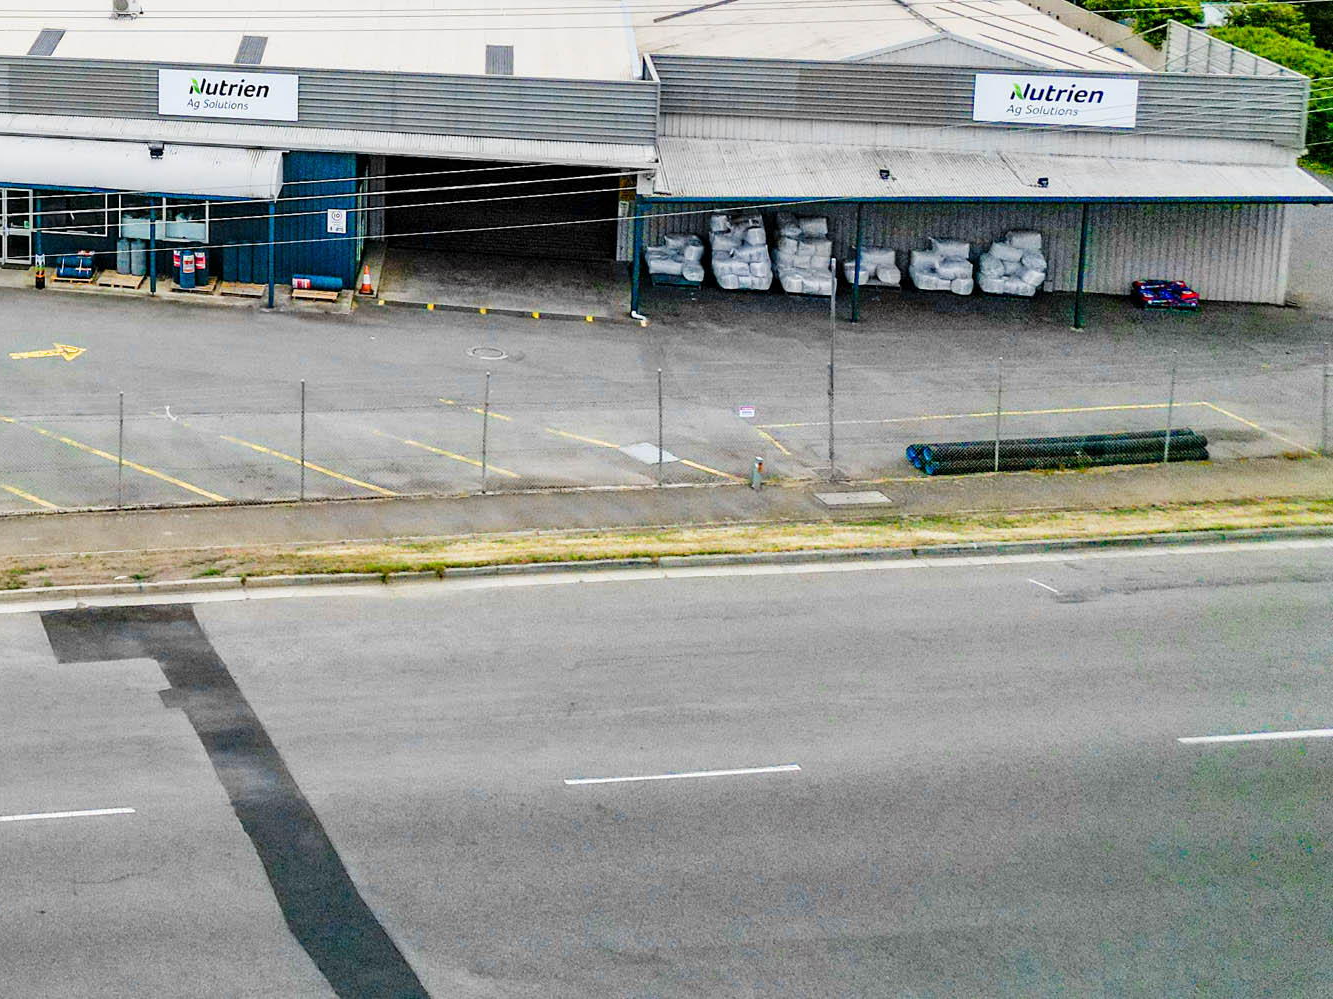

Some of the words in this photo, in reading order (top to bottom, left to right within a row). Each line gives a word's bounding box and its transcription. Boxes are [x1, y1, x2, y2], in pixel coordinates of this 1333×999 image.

[189, 77, 269, 98] Nutrien
[1010, 82, 1104, 103] Nutrien
[187, 98, 200, 110] Ag
[203, 99, 249, 110] Solutions
[1006, 104, 1022, 116] Ag
[1025, 104, 1079, 117] Solutions
